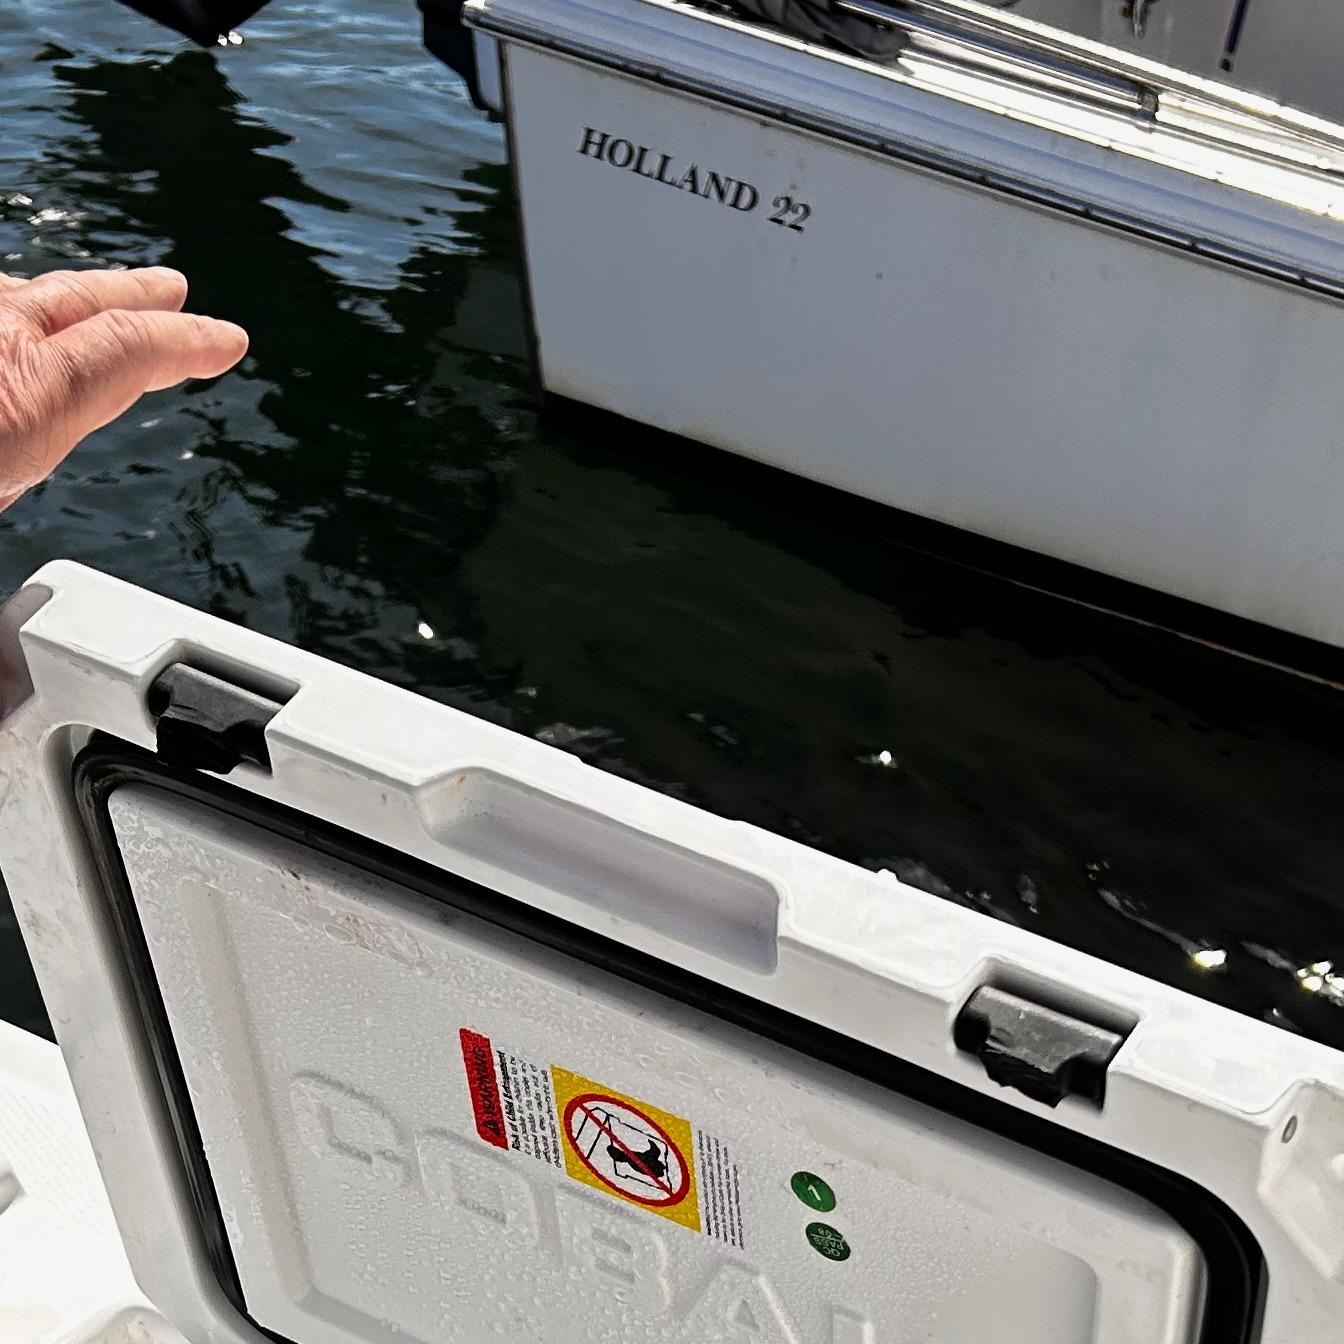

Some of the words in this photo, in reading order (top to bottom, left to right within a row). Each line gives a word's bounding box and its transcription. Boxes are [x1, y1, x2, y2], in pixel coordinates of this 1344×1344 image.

[576, 126, 760, 213] HOLLAND
[766, 194, 812, 234] 22
[807, 1184, 822, 1201] 1
[822, 1246, 841, 1257] QC
